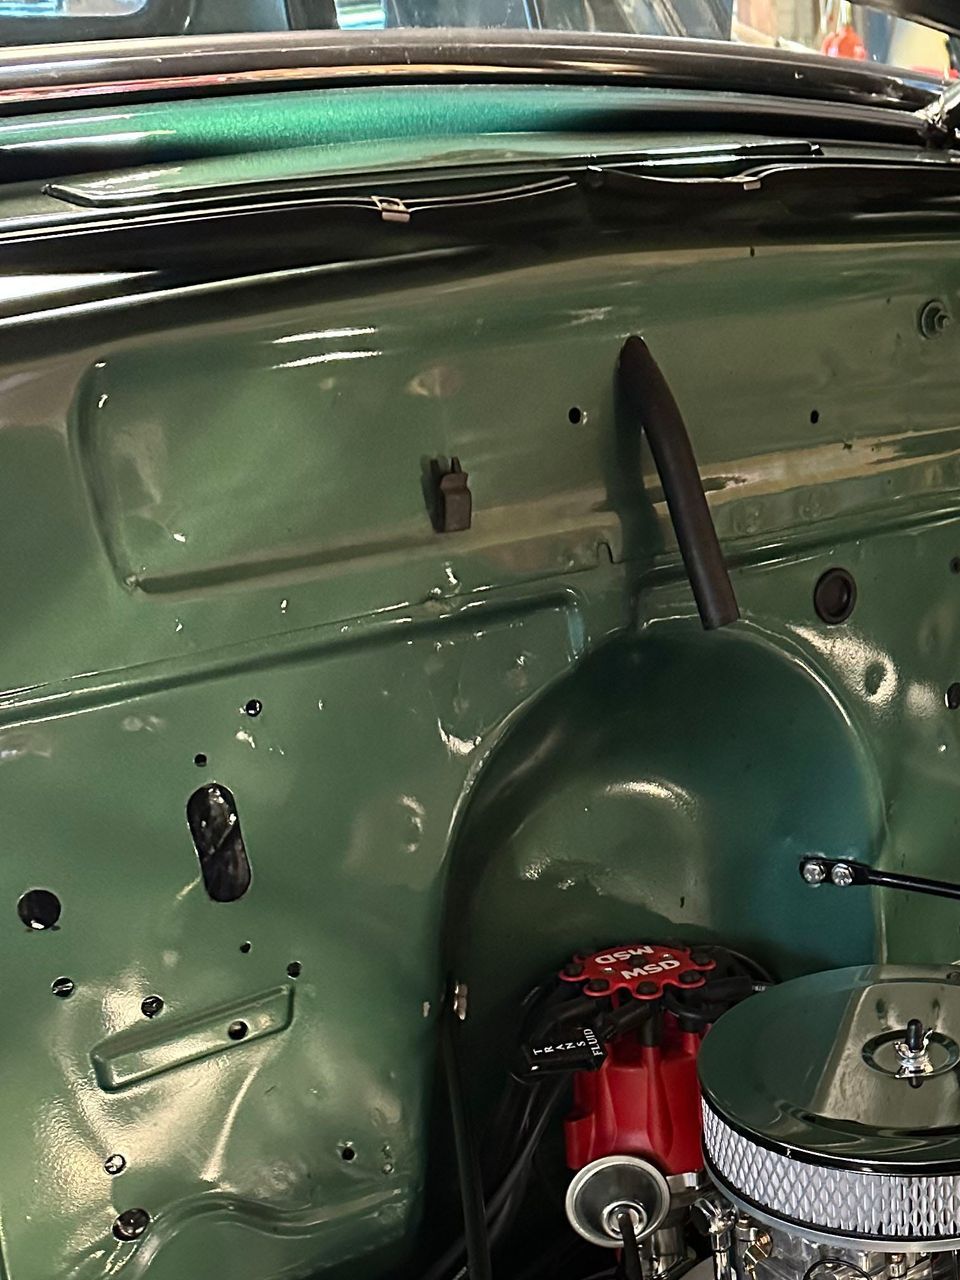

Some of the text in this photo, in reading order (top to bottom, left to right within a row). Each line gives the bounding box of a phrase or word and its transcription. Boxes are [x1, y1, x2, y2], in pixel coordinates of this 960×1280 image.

[595, 946, 654, 964] MSD
[620, 960, 681, 980] MSD
[532, 1040, 586, 1056] TRANS
[583, 1028, 603, 1056] FLUID
